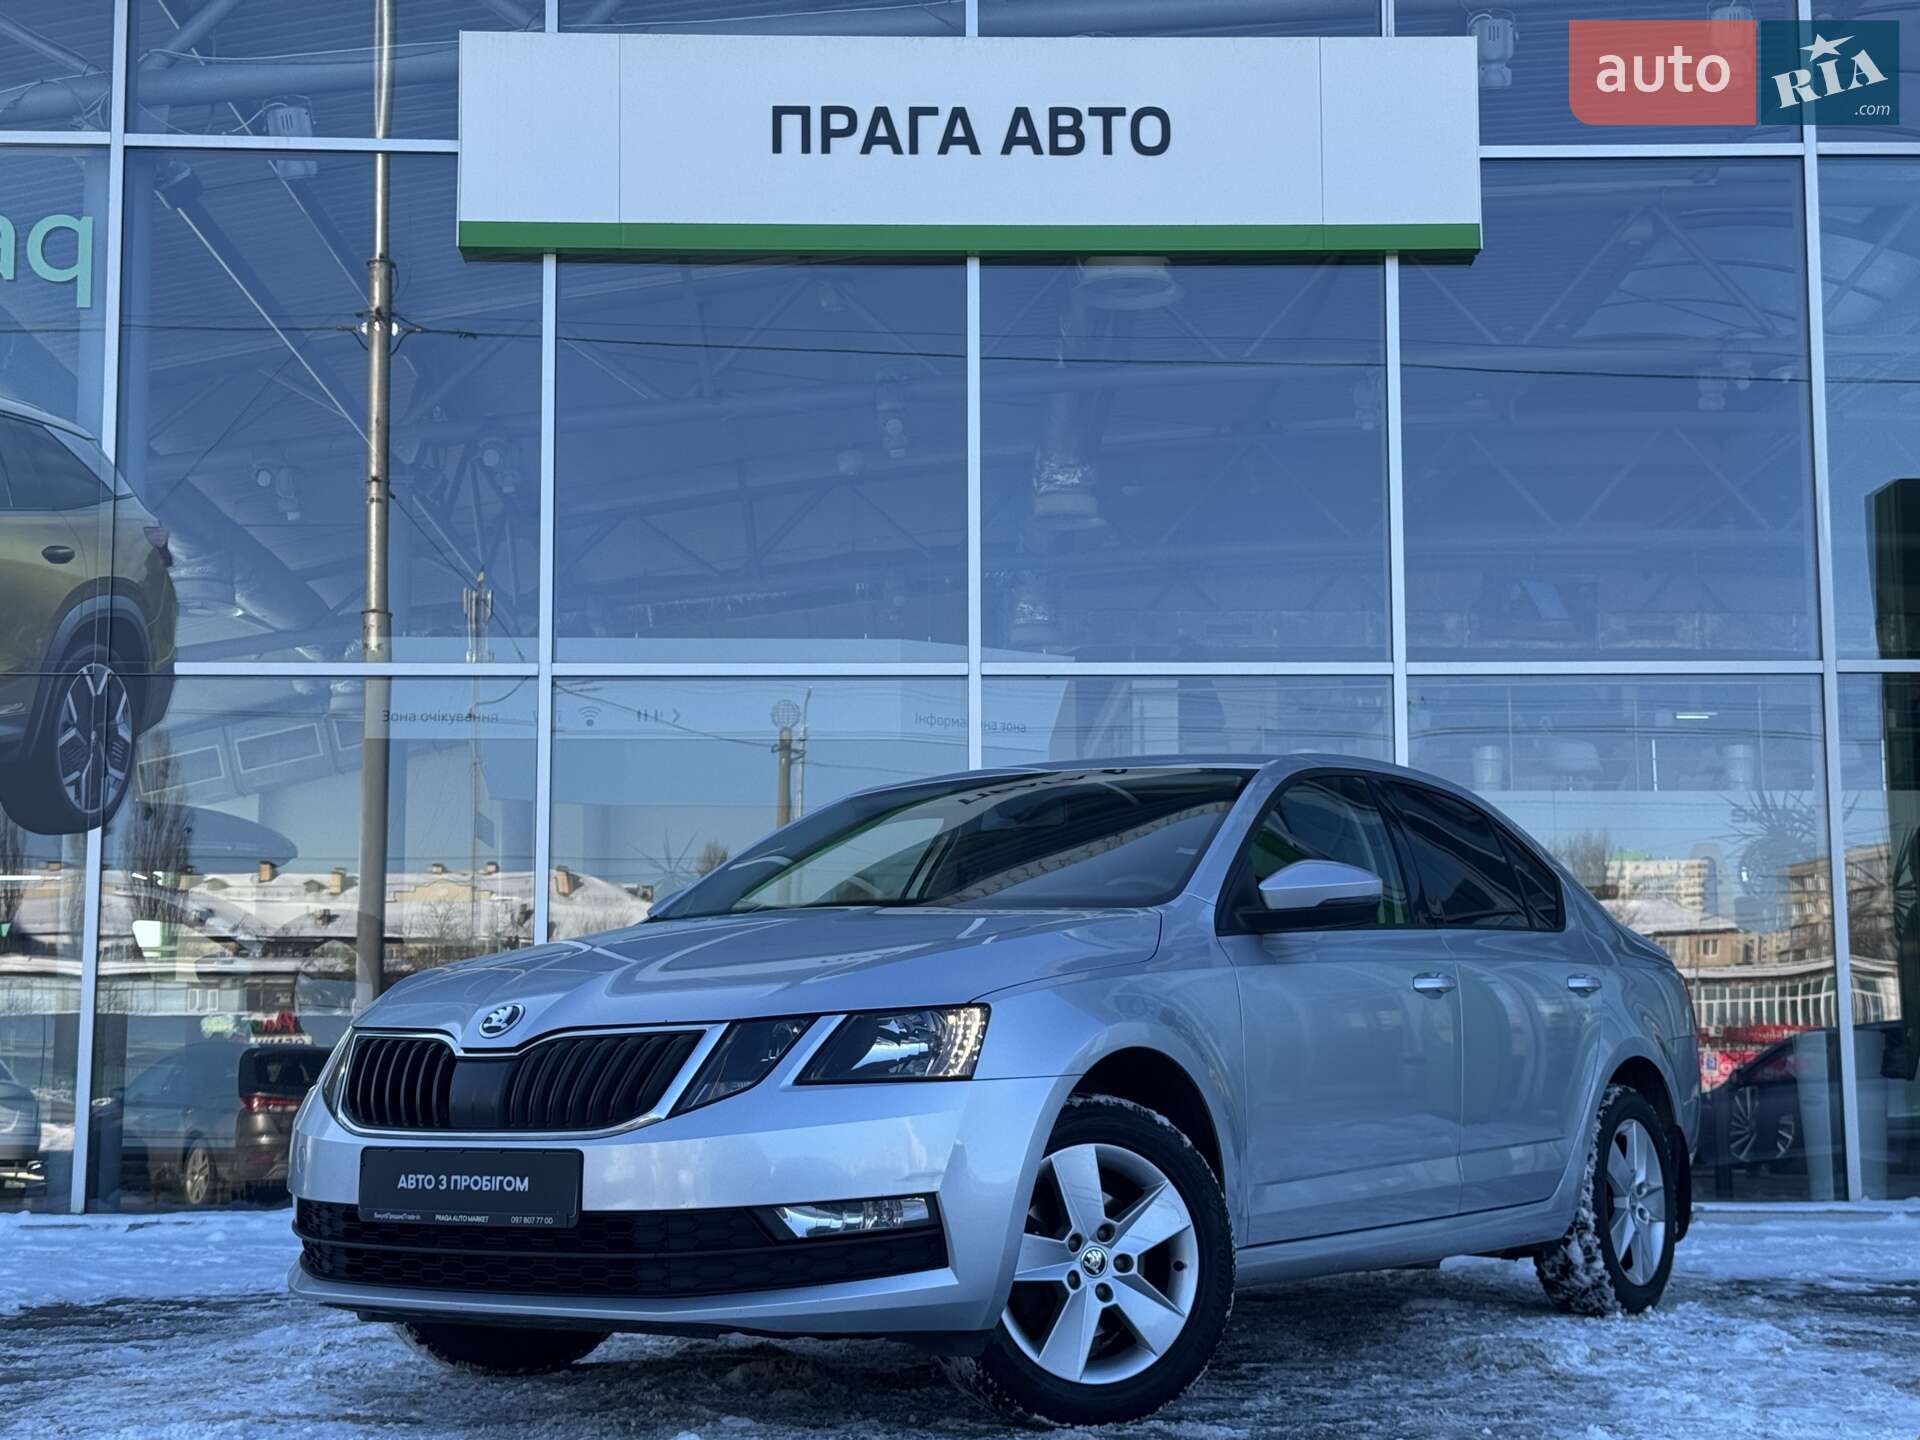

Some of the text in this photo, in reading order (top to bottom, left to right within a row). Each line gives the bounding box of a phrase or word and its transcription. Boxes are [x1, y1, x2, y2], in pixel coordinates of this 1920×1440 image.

[771, 105, 1172, 156] ПРАГА АВТО
[382, 709, 417, 723] Зона
[397, 1174, 436, 1190] АВТО
[450, 1175, 529, 1192] ПРОБІГОМ
[535, 1216, 544, 1224] 77
[543, 1216, 554, 1225] 00
